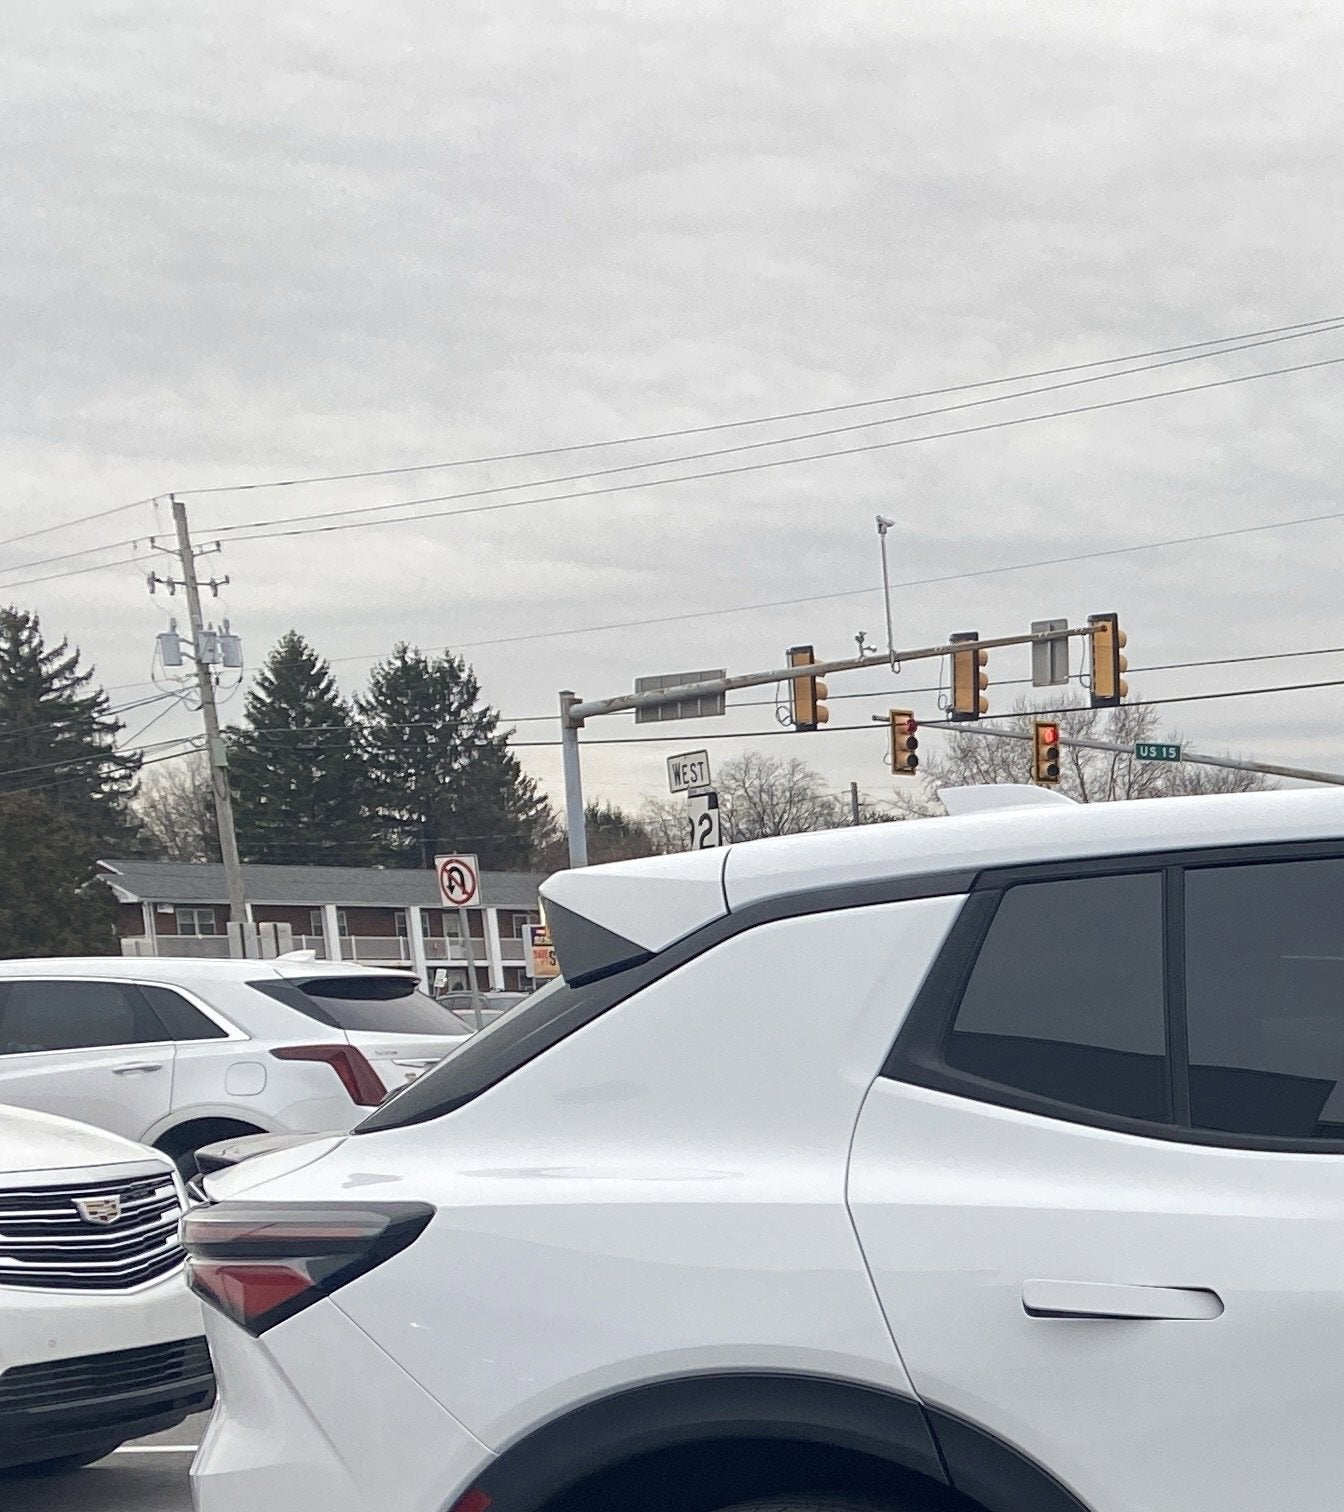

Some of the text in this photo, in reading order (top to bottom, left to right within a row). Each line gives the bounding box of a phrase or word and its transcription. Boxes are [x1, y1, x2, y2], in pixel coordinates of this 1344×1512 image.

[1140, 745, 1177, 759] US 15
[672, 761, 704, 787] WEST
